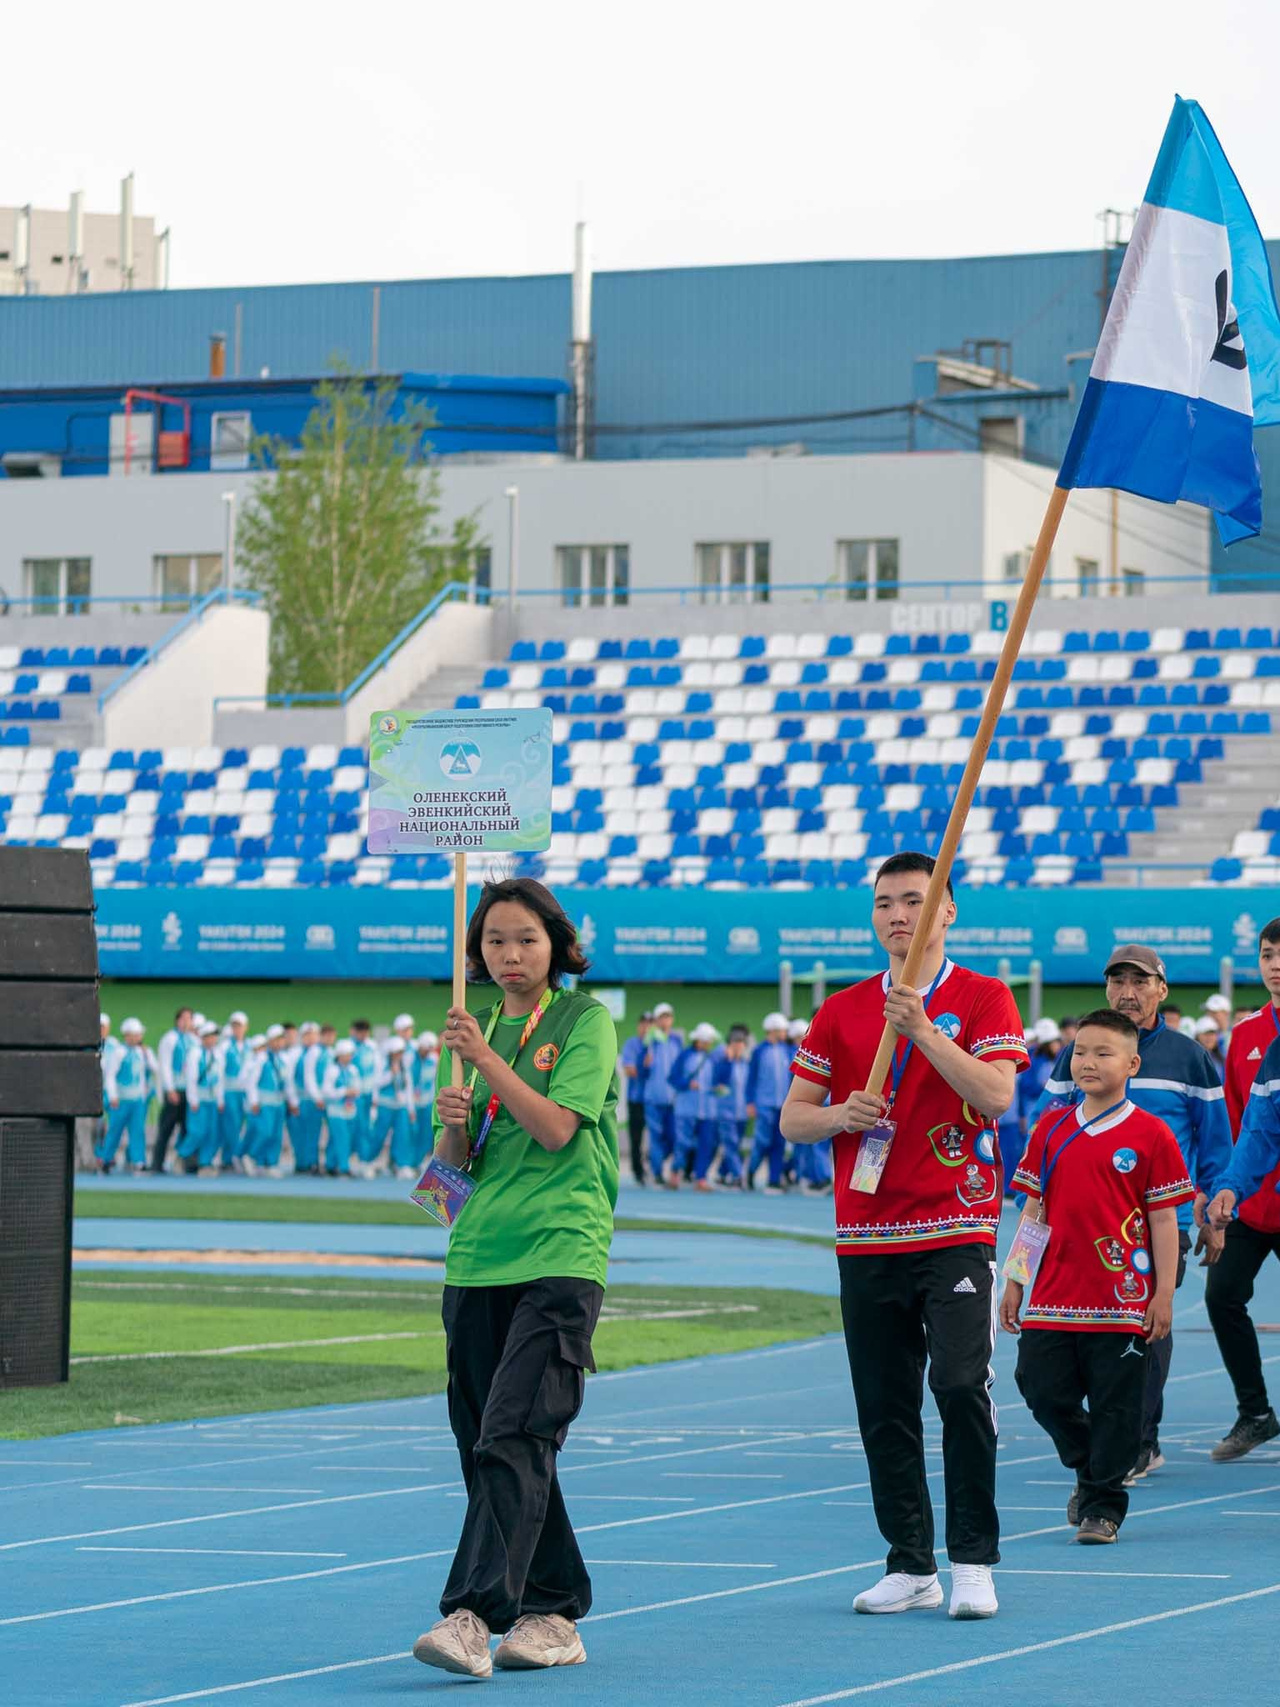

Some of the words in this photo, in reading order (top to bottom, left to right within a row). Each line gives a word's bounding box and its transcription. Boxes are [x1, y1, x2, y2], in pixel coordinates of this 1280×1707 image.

[413, 788, 507, 803] ОЛЕНЕКСКИЙ
[408, 803, 511, 818] ЭВЕНКИЙСКИЙ
[400, 817, 520, 833] НАЦИОНАЛЬНЫЙ
[435, 832, 483, 846] РАЙОН
